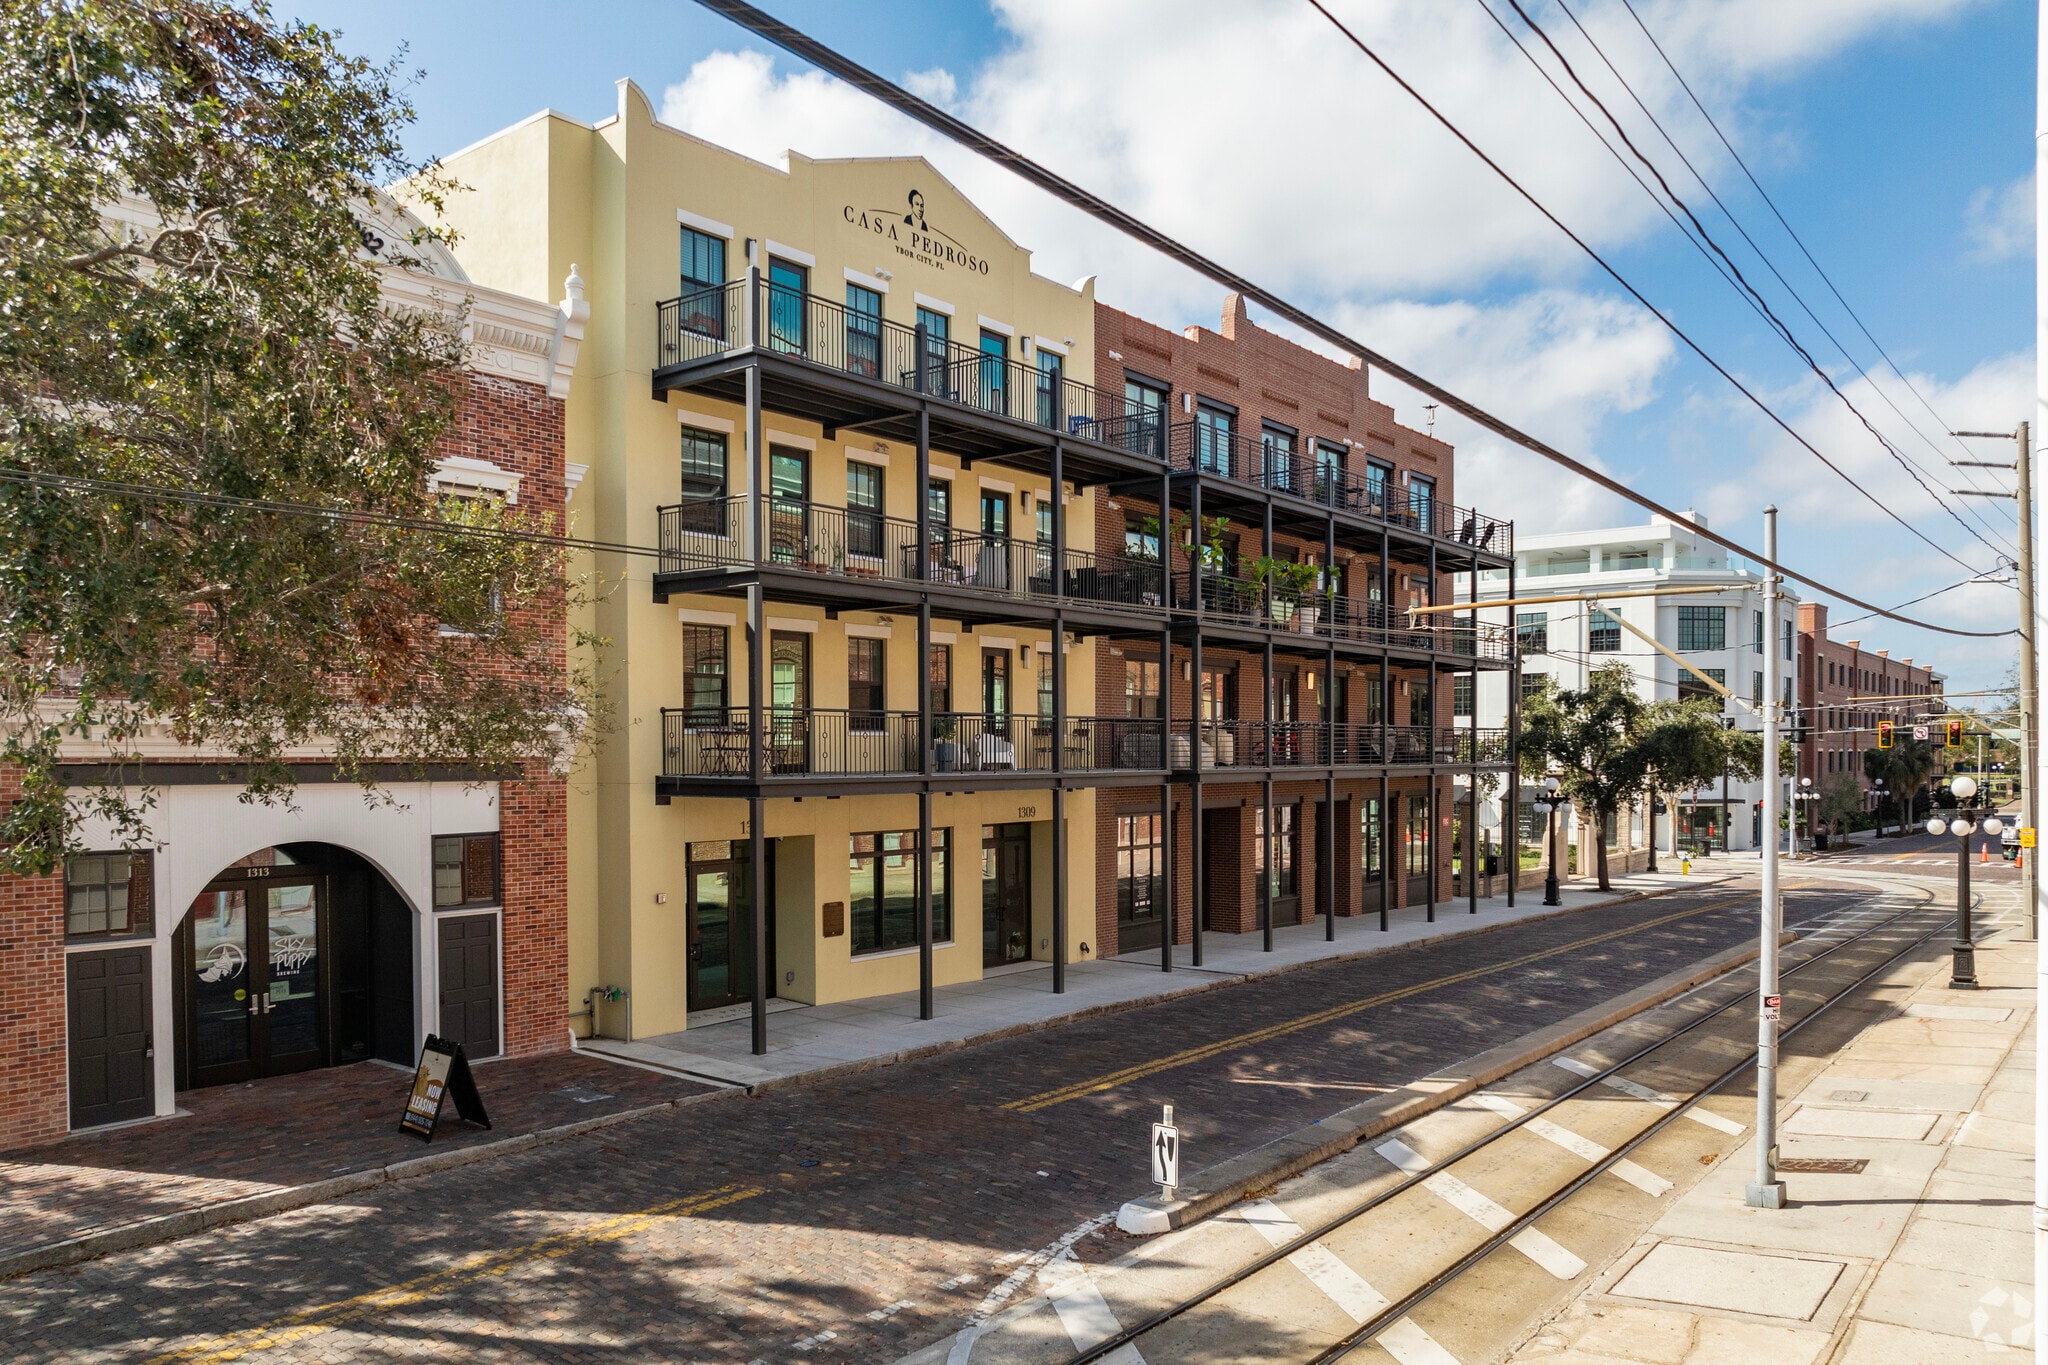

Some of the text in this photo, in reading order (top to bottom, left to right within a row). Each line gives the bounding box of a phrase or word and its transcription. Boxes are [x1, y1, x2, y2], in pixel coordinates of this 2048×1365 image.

[843, 205, 989, 276] CASA PEDROSO
[895, 245, 945, 271] YBOR CITY, FL
[1017, 806, 1037, 819] 1309
[247, 867, 270, 878] 1313
[274, 937, 306, 958] SKY
[276, 951, 312, 971] PUPPY
[426, 1084, 443, 1100] NOW
[411, 1094, 438, 1115] LEASING
